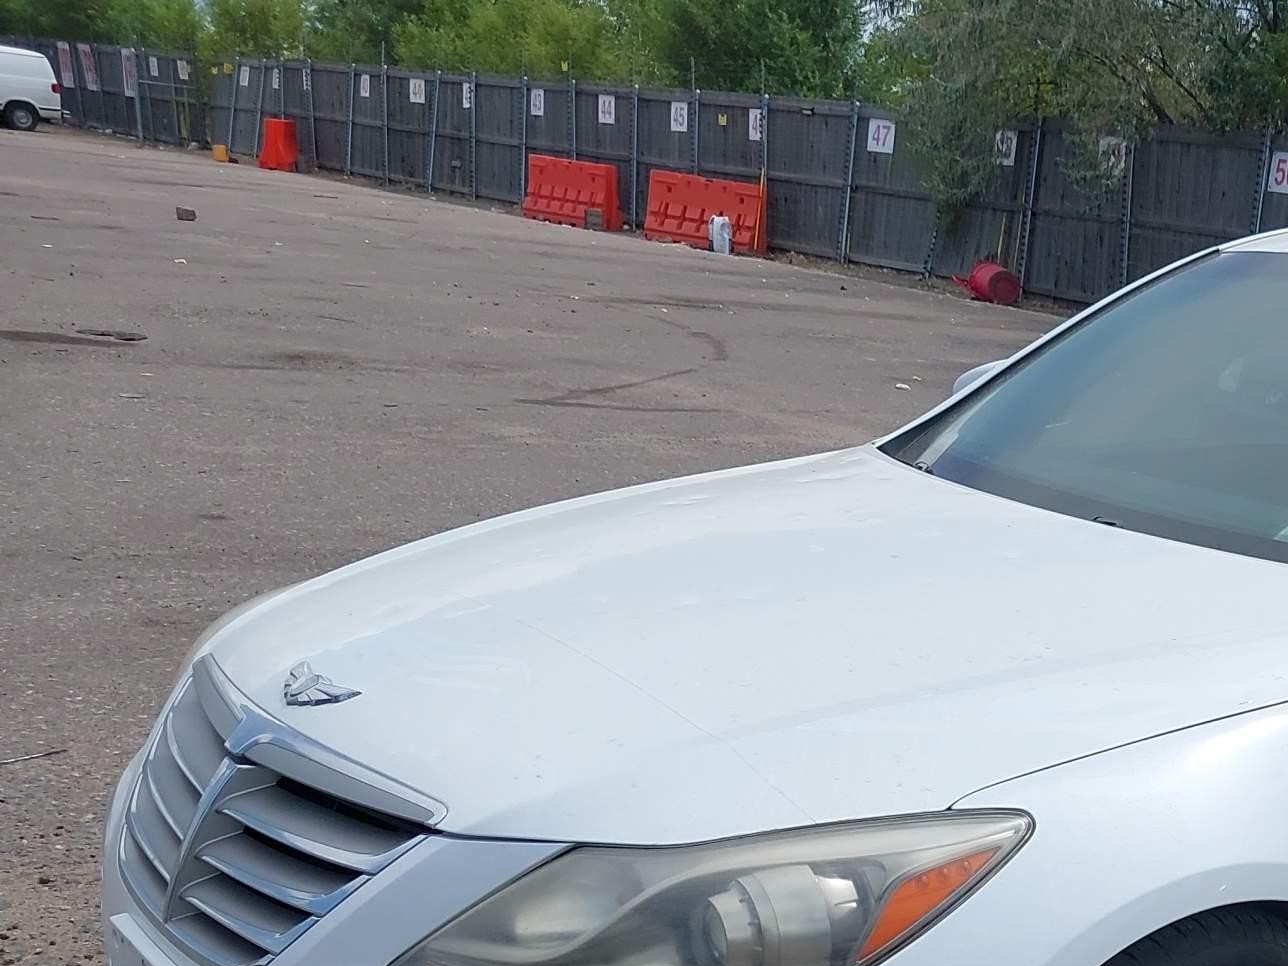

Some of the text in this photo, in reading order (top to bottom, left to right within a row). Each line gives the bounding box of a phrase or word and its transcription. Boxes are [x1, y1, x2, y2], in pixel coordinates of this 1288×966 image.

[600, 99, 612, 119] 44
[673, 106, 685, 127] 45
[872, 124, 892, 147] 47
